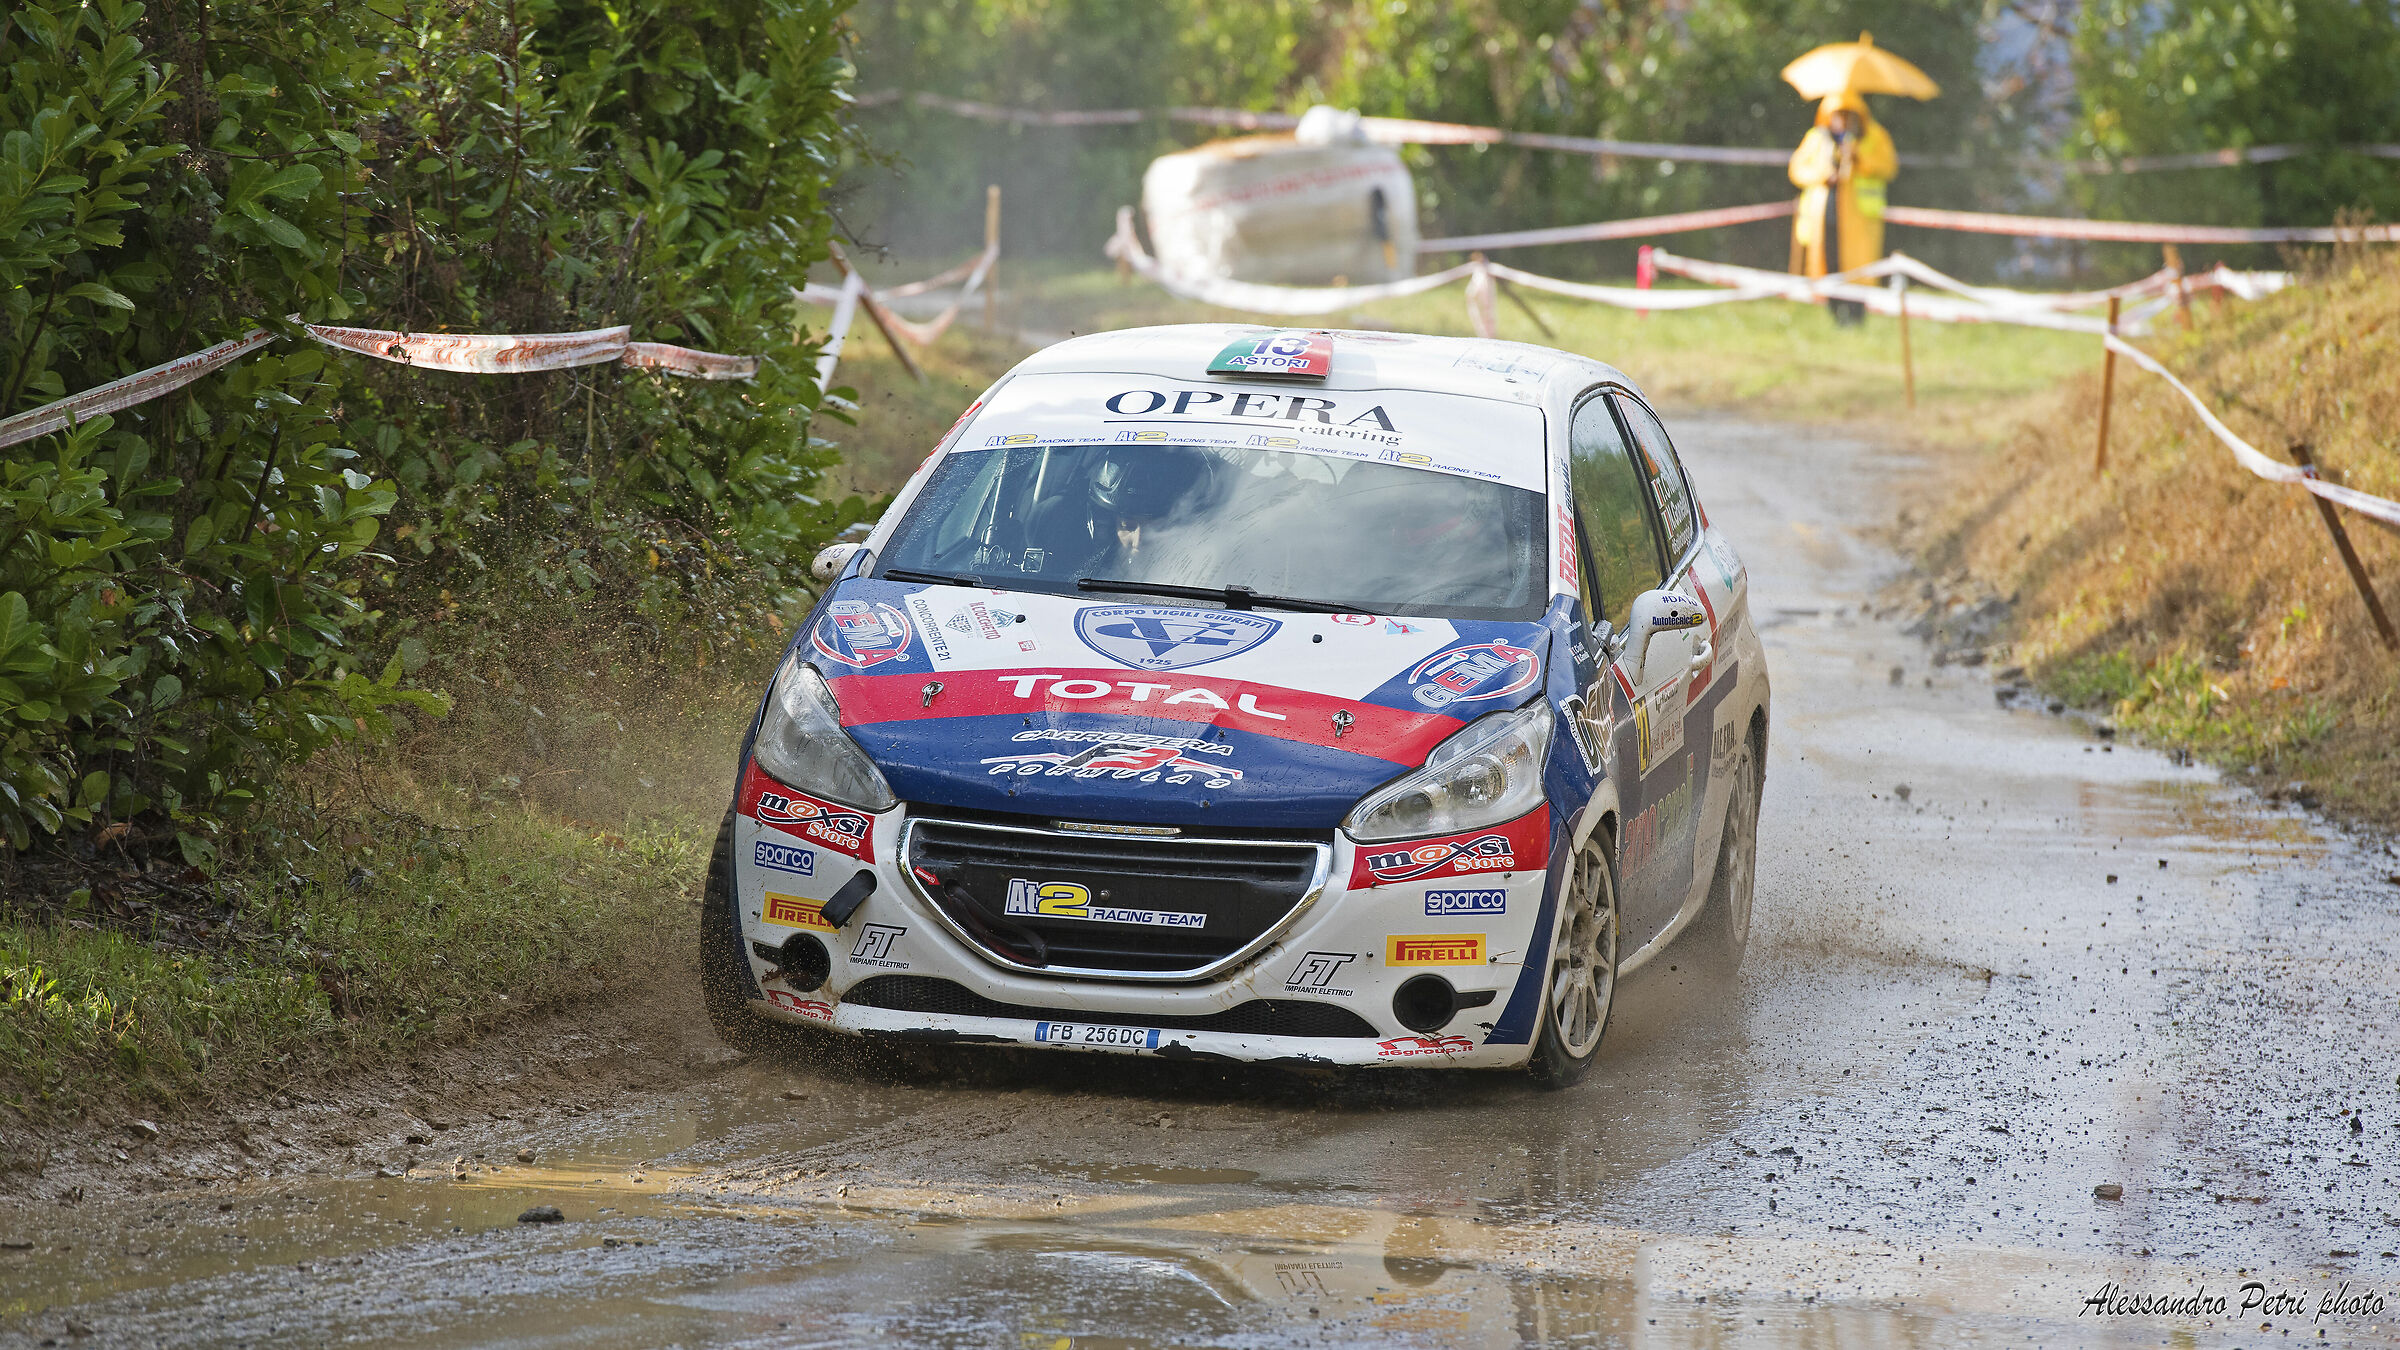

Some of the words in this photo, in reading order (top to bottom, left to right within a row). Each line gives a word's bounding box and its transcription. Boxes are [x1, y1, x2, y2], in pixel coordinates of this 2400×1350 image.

[1251, 337, 1310, 356] 13
[1229, 356, 1308, 368] ASTORI
[1105, 390, 1403, 433] OPERA
[985, 433, 1038, 447] At2
[1115, 431, 1168, 442] At2
[1246, 434, 1300, 449] At2
[1299, 445, 1338, 453] RACING
[1341, 450, 1369, 458] TEAM
[1299, 426, 1402, 446] catering
[1378, 449, 1433, 467] At2
[1432, 463, 1470, 474] RACING
[1473, 470, 1502, 479] TEAM
[1557, 504, 1577, 592] REDI
[913, 600, 947, 651] CONCORRENTE
[938, 652, 951, 662] 21
[1091, 609, 1146, 617] CORPO
[1152, 609, 1200, 618] VIGILI
[1204, 614, 1266, 629] GIURATI
[1139, 657, 1173, 665] 1925
[1412, 644, 1530, 708] GEMA
[997, 674, 1287, 721] TOTAL
[1012, 728, 1234, 755] CARROZZERIA
[988, 763, 1194, 785] FORMULA
[1203, 778, 1231, 789] 3
[806, 822, 860, 849] Store
[756, 843, 812, 869] sparco
[1453, 856, 1515, 871] Store
[1005, 879, 1090, 918] At2
[1093, 909, 1153, 923] RACING
[1159, 913, 1204, 926] TEAM
[1427, 890, 1504, 914] sparco
[850, 922, 908, 958] FT
[1396, 939, 1478, 961] PIRELLI
[850, 956, 878, 967] IMPIANTI
[878, 958, 909, 970] ELETTRICI
[1286, 951, 1357, 986] FT
[1284, 984, 1317, 994] IMPIANTI
[1318, 987, 1353, 997] ELETTRICI
[1050, 1025, 1073, 1040] FB
[1378, 1045, 1474, 1057] d6group.it
